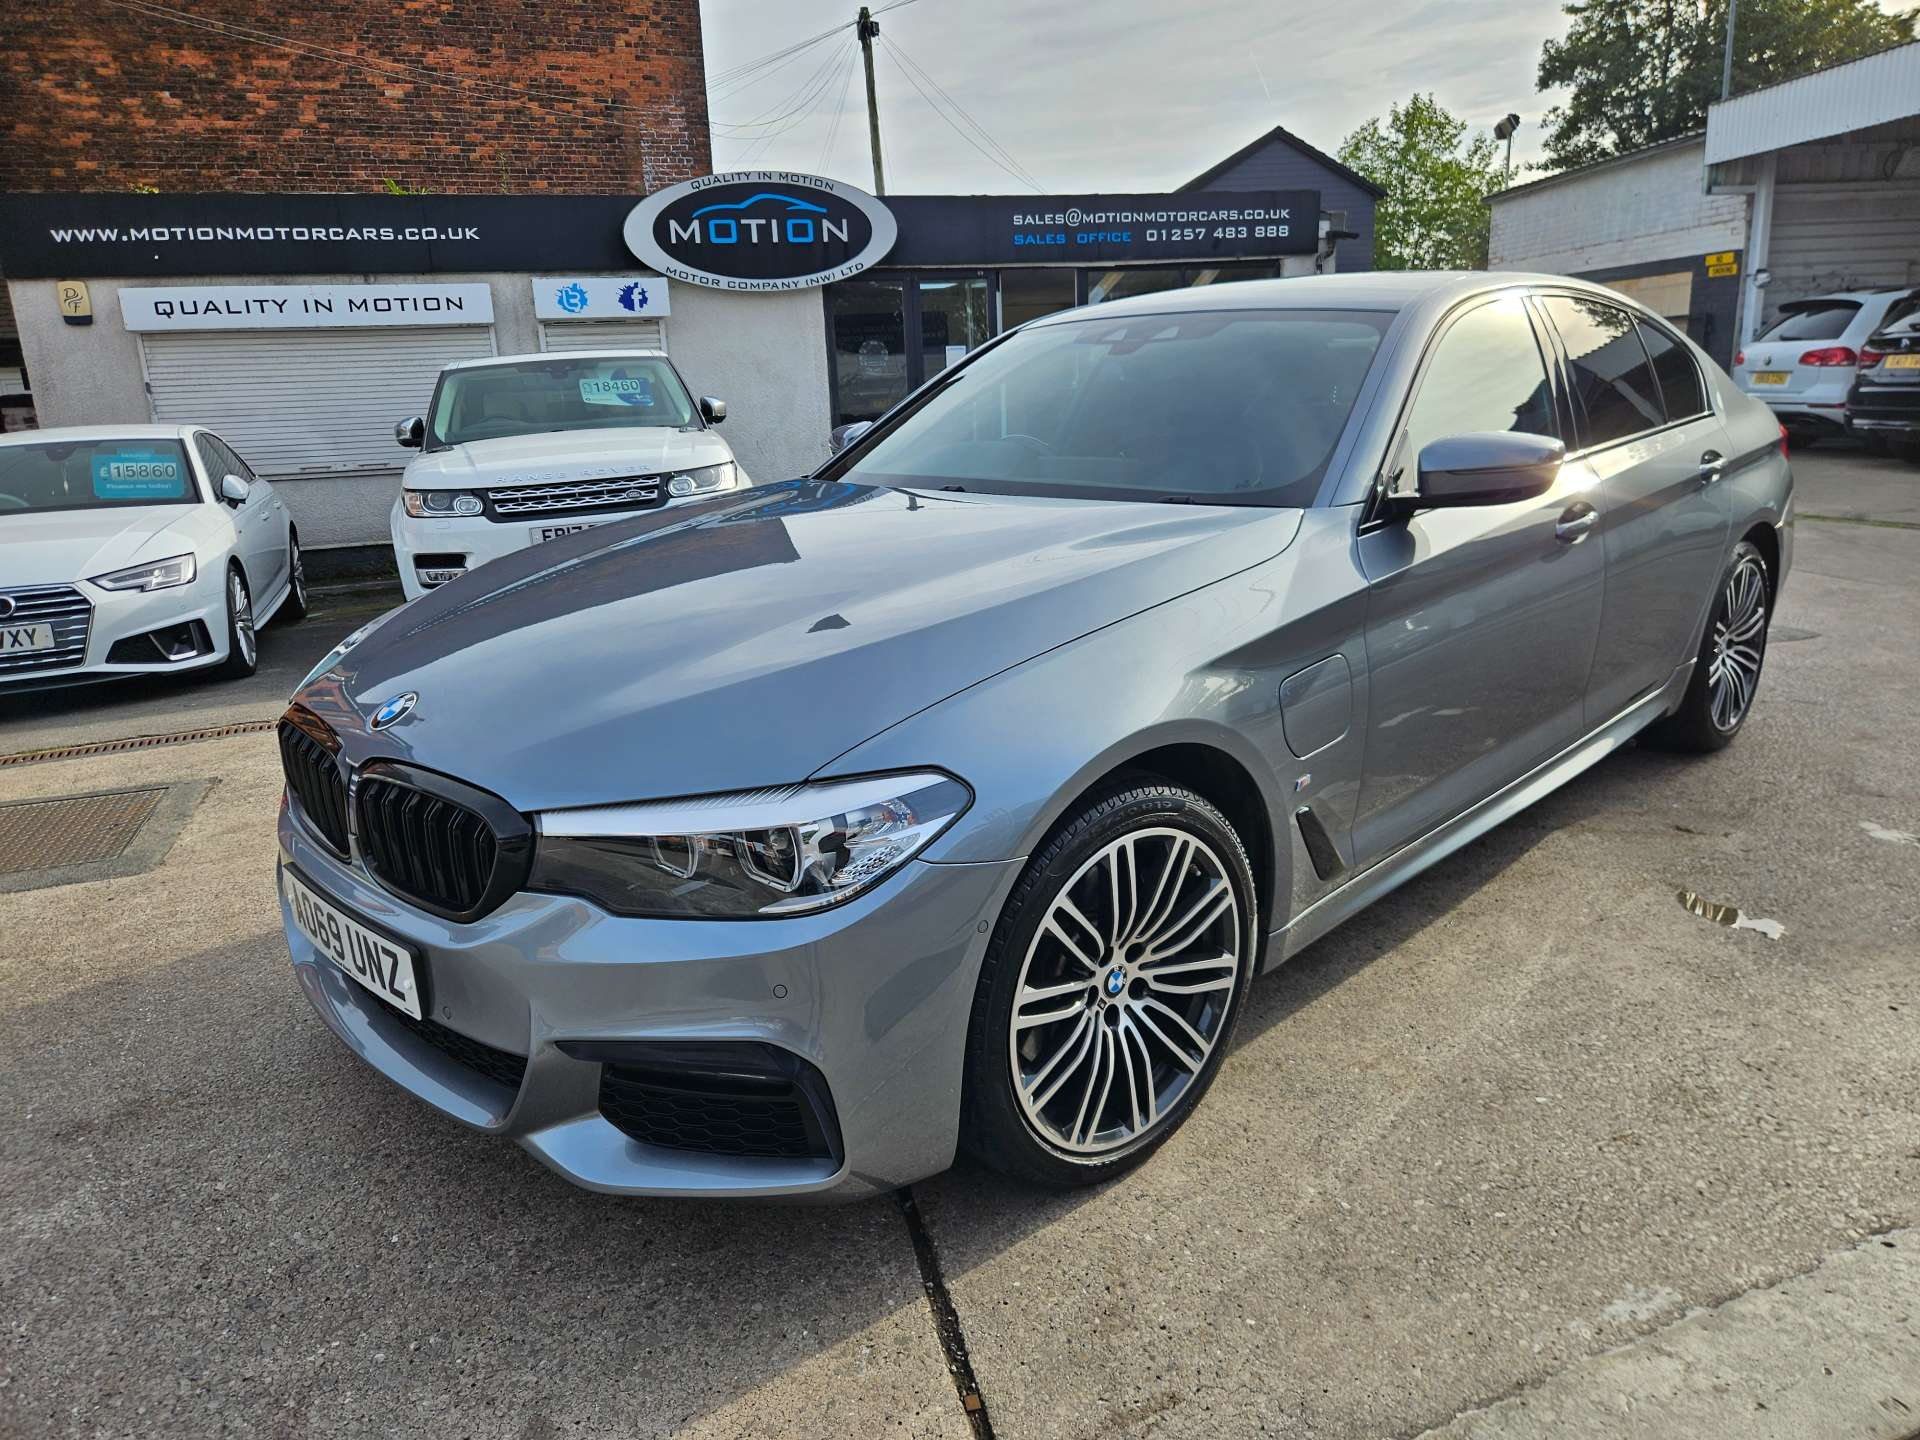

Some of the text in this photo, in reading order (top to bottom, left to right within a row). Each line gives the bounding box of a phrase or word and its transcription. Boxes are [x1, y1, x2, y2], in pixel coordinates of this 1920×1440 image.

[691, 172, 835, 191] QUALITY IN MOTION
[1013, 208, 1290, 227] SALES@MOTIONMOTORCARS.CO.UK
[50, 227, 480, 243] WWW.MOTIONMOTORCARS.CO.UK
[668, 218, 849, 244] MOTION
[1014, 225, 1289, 245] SALES OFFICE 01257 483 888
[665, 266, 721, 287] MOTOR
[727, 280, 800, 290] COMPANY
[841, 262, 864, 277] LTD
[154, 297, 464, 318] QUALITY IN MOTION
[345, 924, 406, 1002] UNZ
